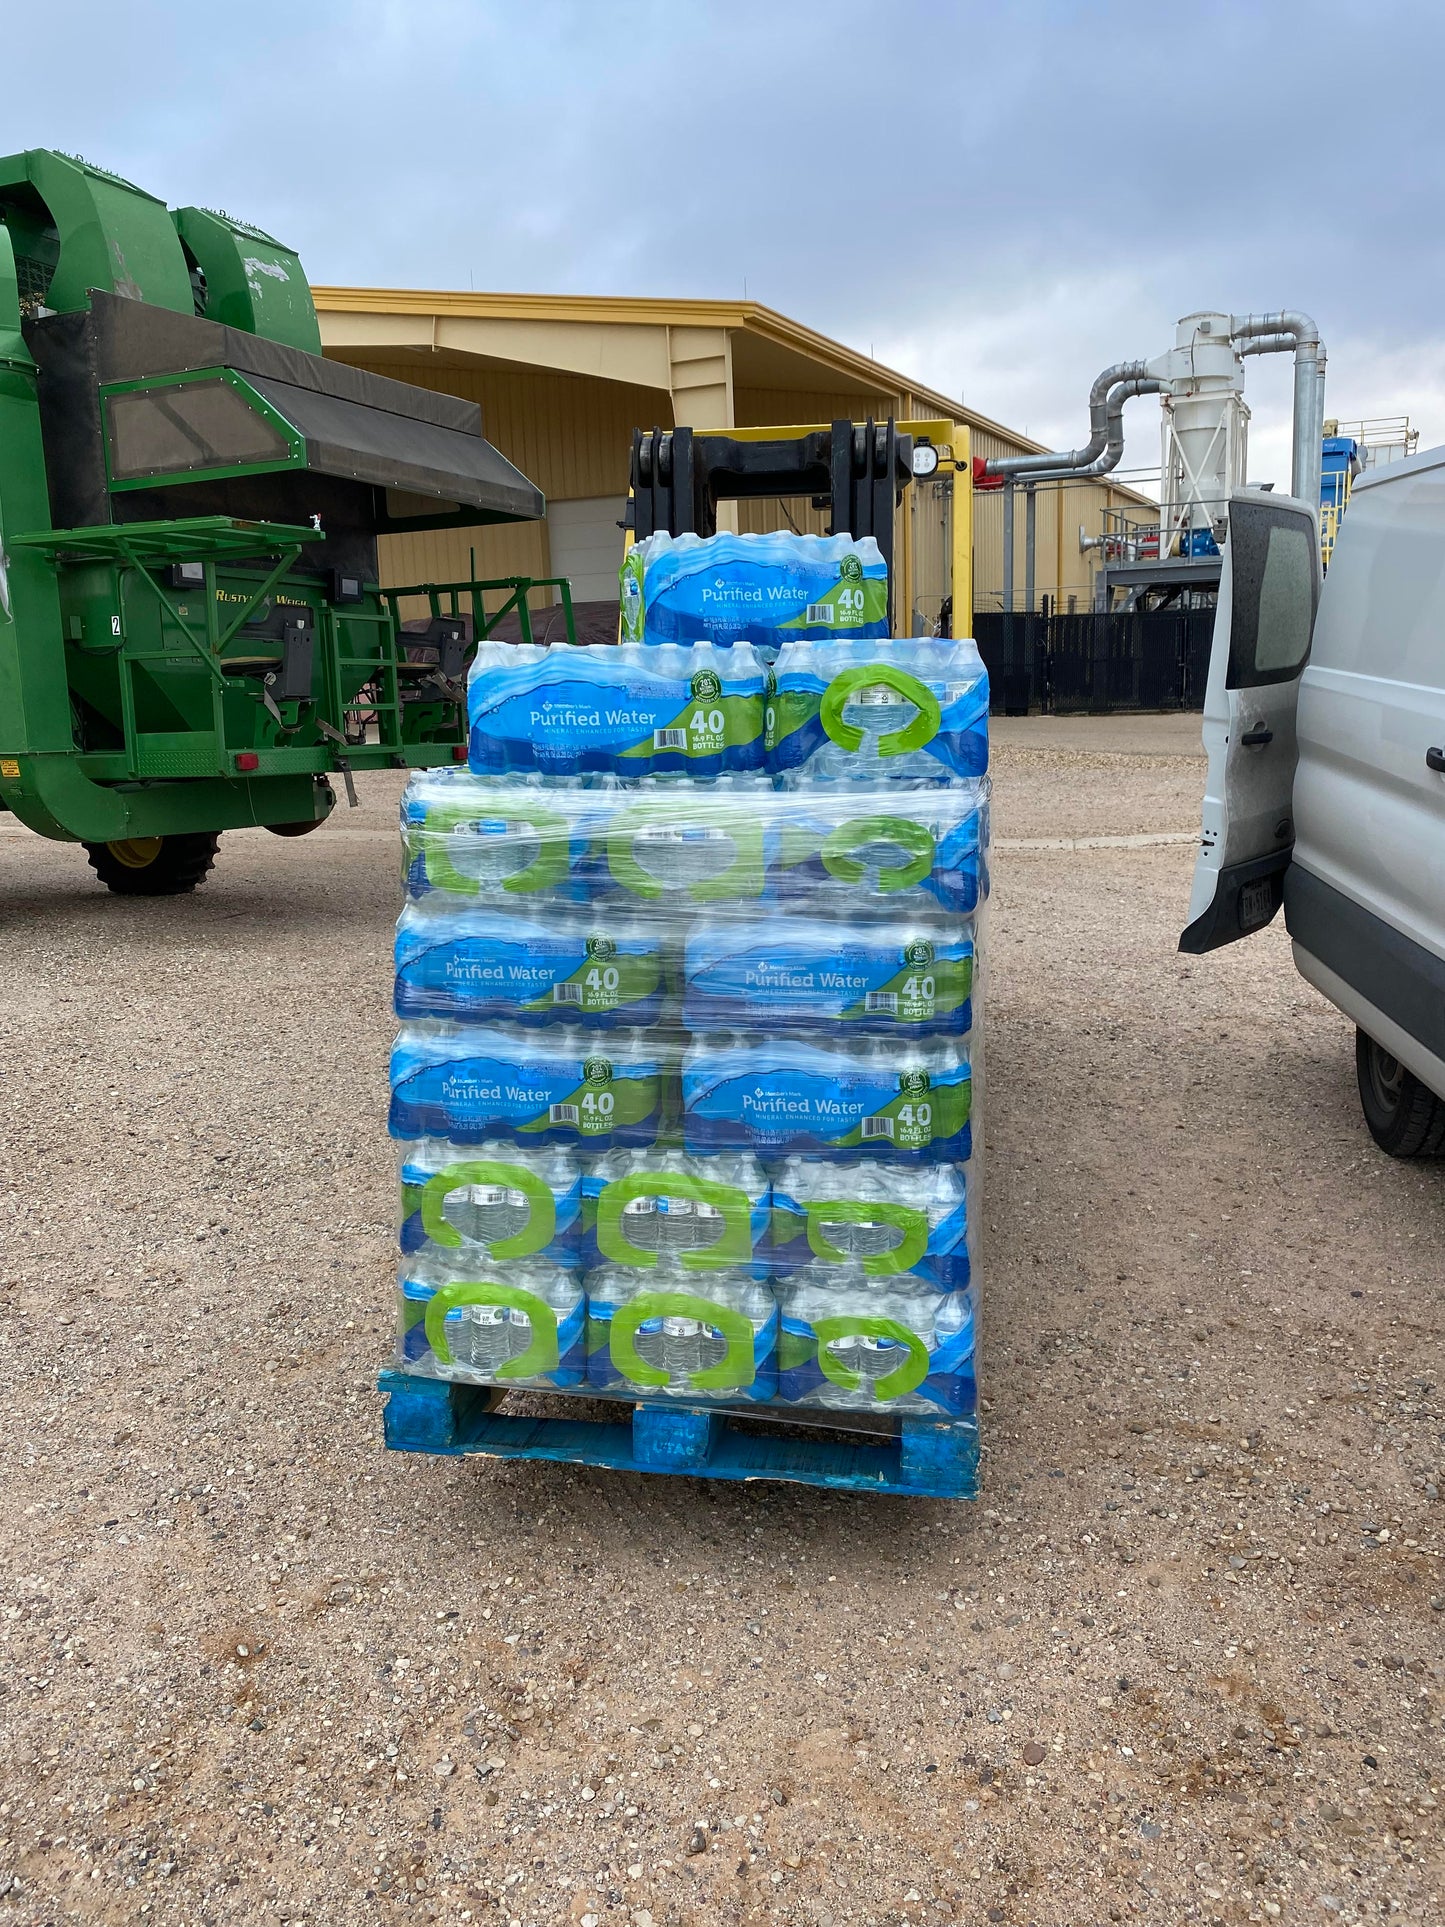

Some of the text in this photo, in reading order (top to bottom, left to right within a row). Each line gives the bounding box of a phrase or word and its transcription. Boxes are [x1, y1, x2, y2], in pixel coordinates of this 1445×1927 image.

[702, 586, 808, 602] Purified Water
[838, 588, 864, 610] 40
[113, 617, 120, 634] 2
[530, 710, 656, 726] Purified Water
[690, 710, 724, 734] 40
[692, 742, 724, 750] BOTTLES
[446, 962, 556, 980] Purified Water
[585, 968, 619, 990] 40
[745, 971, 868, 988] Purified Water
[902, 976, 935, 1000] 40
[904, 1008, 934, 1016] BOTTLES
[442, 1082, 552, 1101] Purified Water
[582, 1093, 614, 1114] 40
[742, 1094, 864, 1114] Purified Water
[898, 1103, 931, 1126] 40
[900, 1134, 931, 1142] BOTTLES
